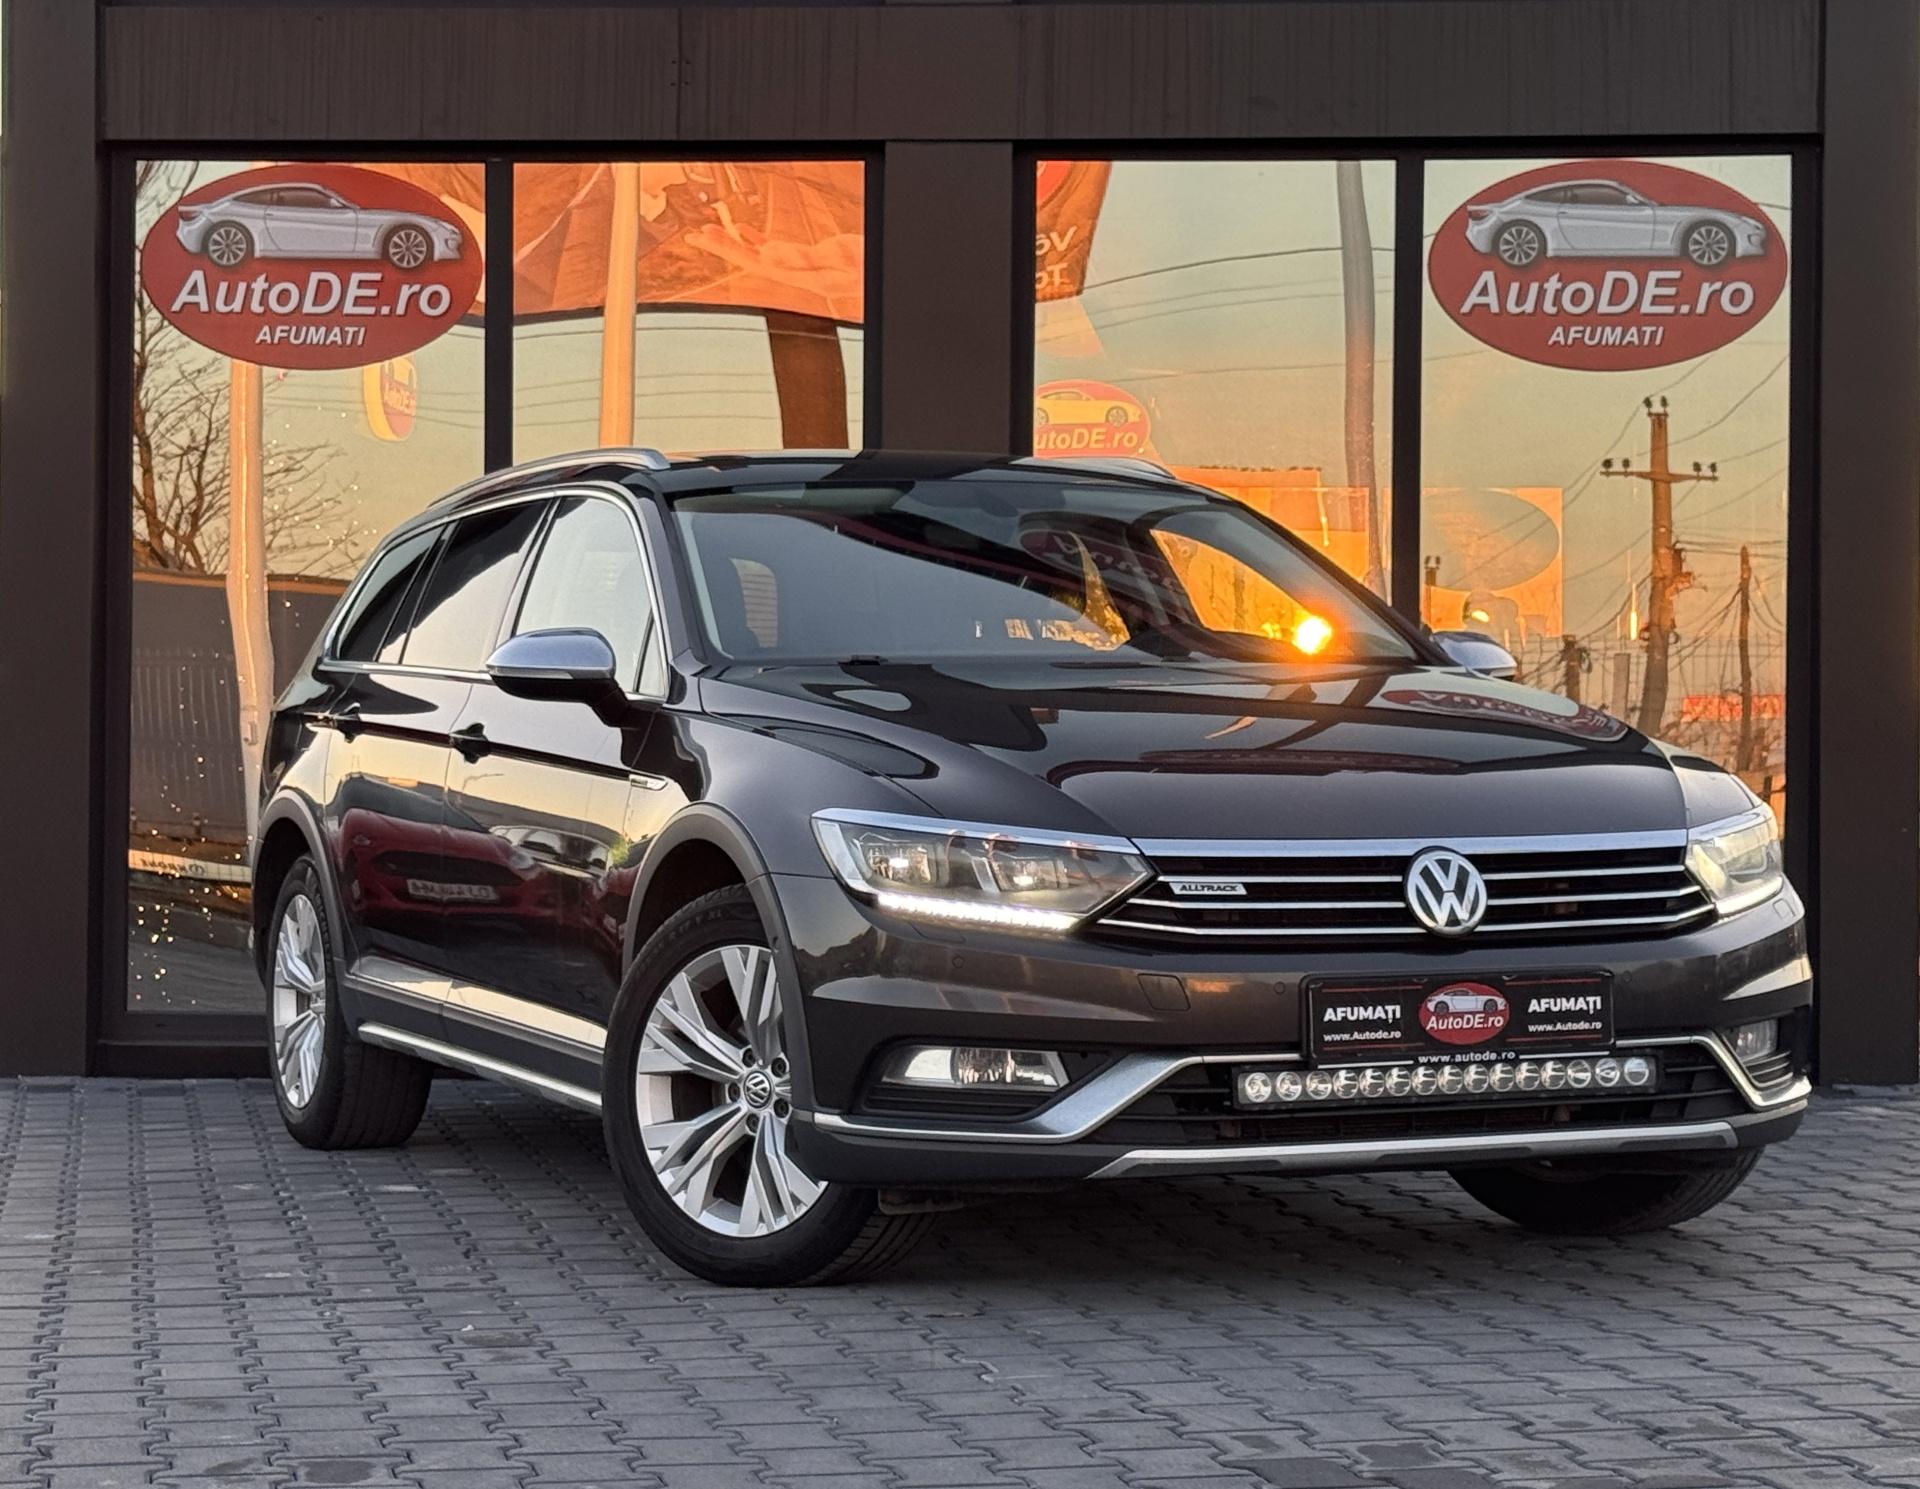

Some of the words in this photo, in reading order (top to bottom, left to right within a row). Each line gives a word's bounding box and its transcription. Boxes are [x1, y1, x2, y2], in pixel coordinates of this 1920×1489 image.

[171, 270, 451, 316] AutoDE.ro
[1460, 270, 1754, 315] AutoDE.ro
[255, 325, 366, 346] AFUMATI
[1548, 325, 1664, 346] AFUMATI
[1035, 428, 1138, 450] utoDE.ro
[1179, 884, 1239, 893] ALLTRACK
[1425, 1013, 1505, 1031] AutoDE.ro
[1528, 1020, 1603, 1033] www.Autode.ro
[1323, 1030, 1402, 1042] www.Autode.ro
[1418, 1051, 1516, 1063] www.autode.ro
